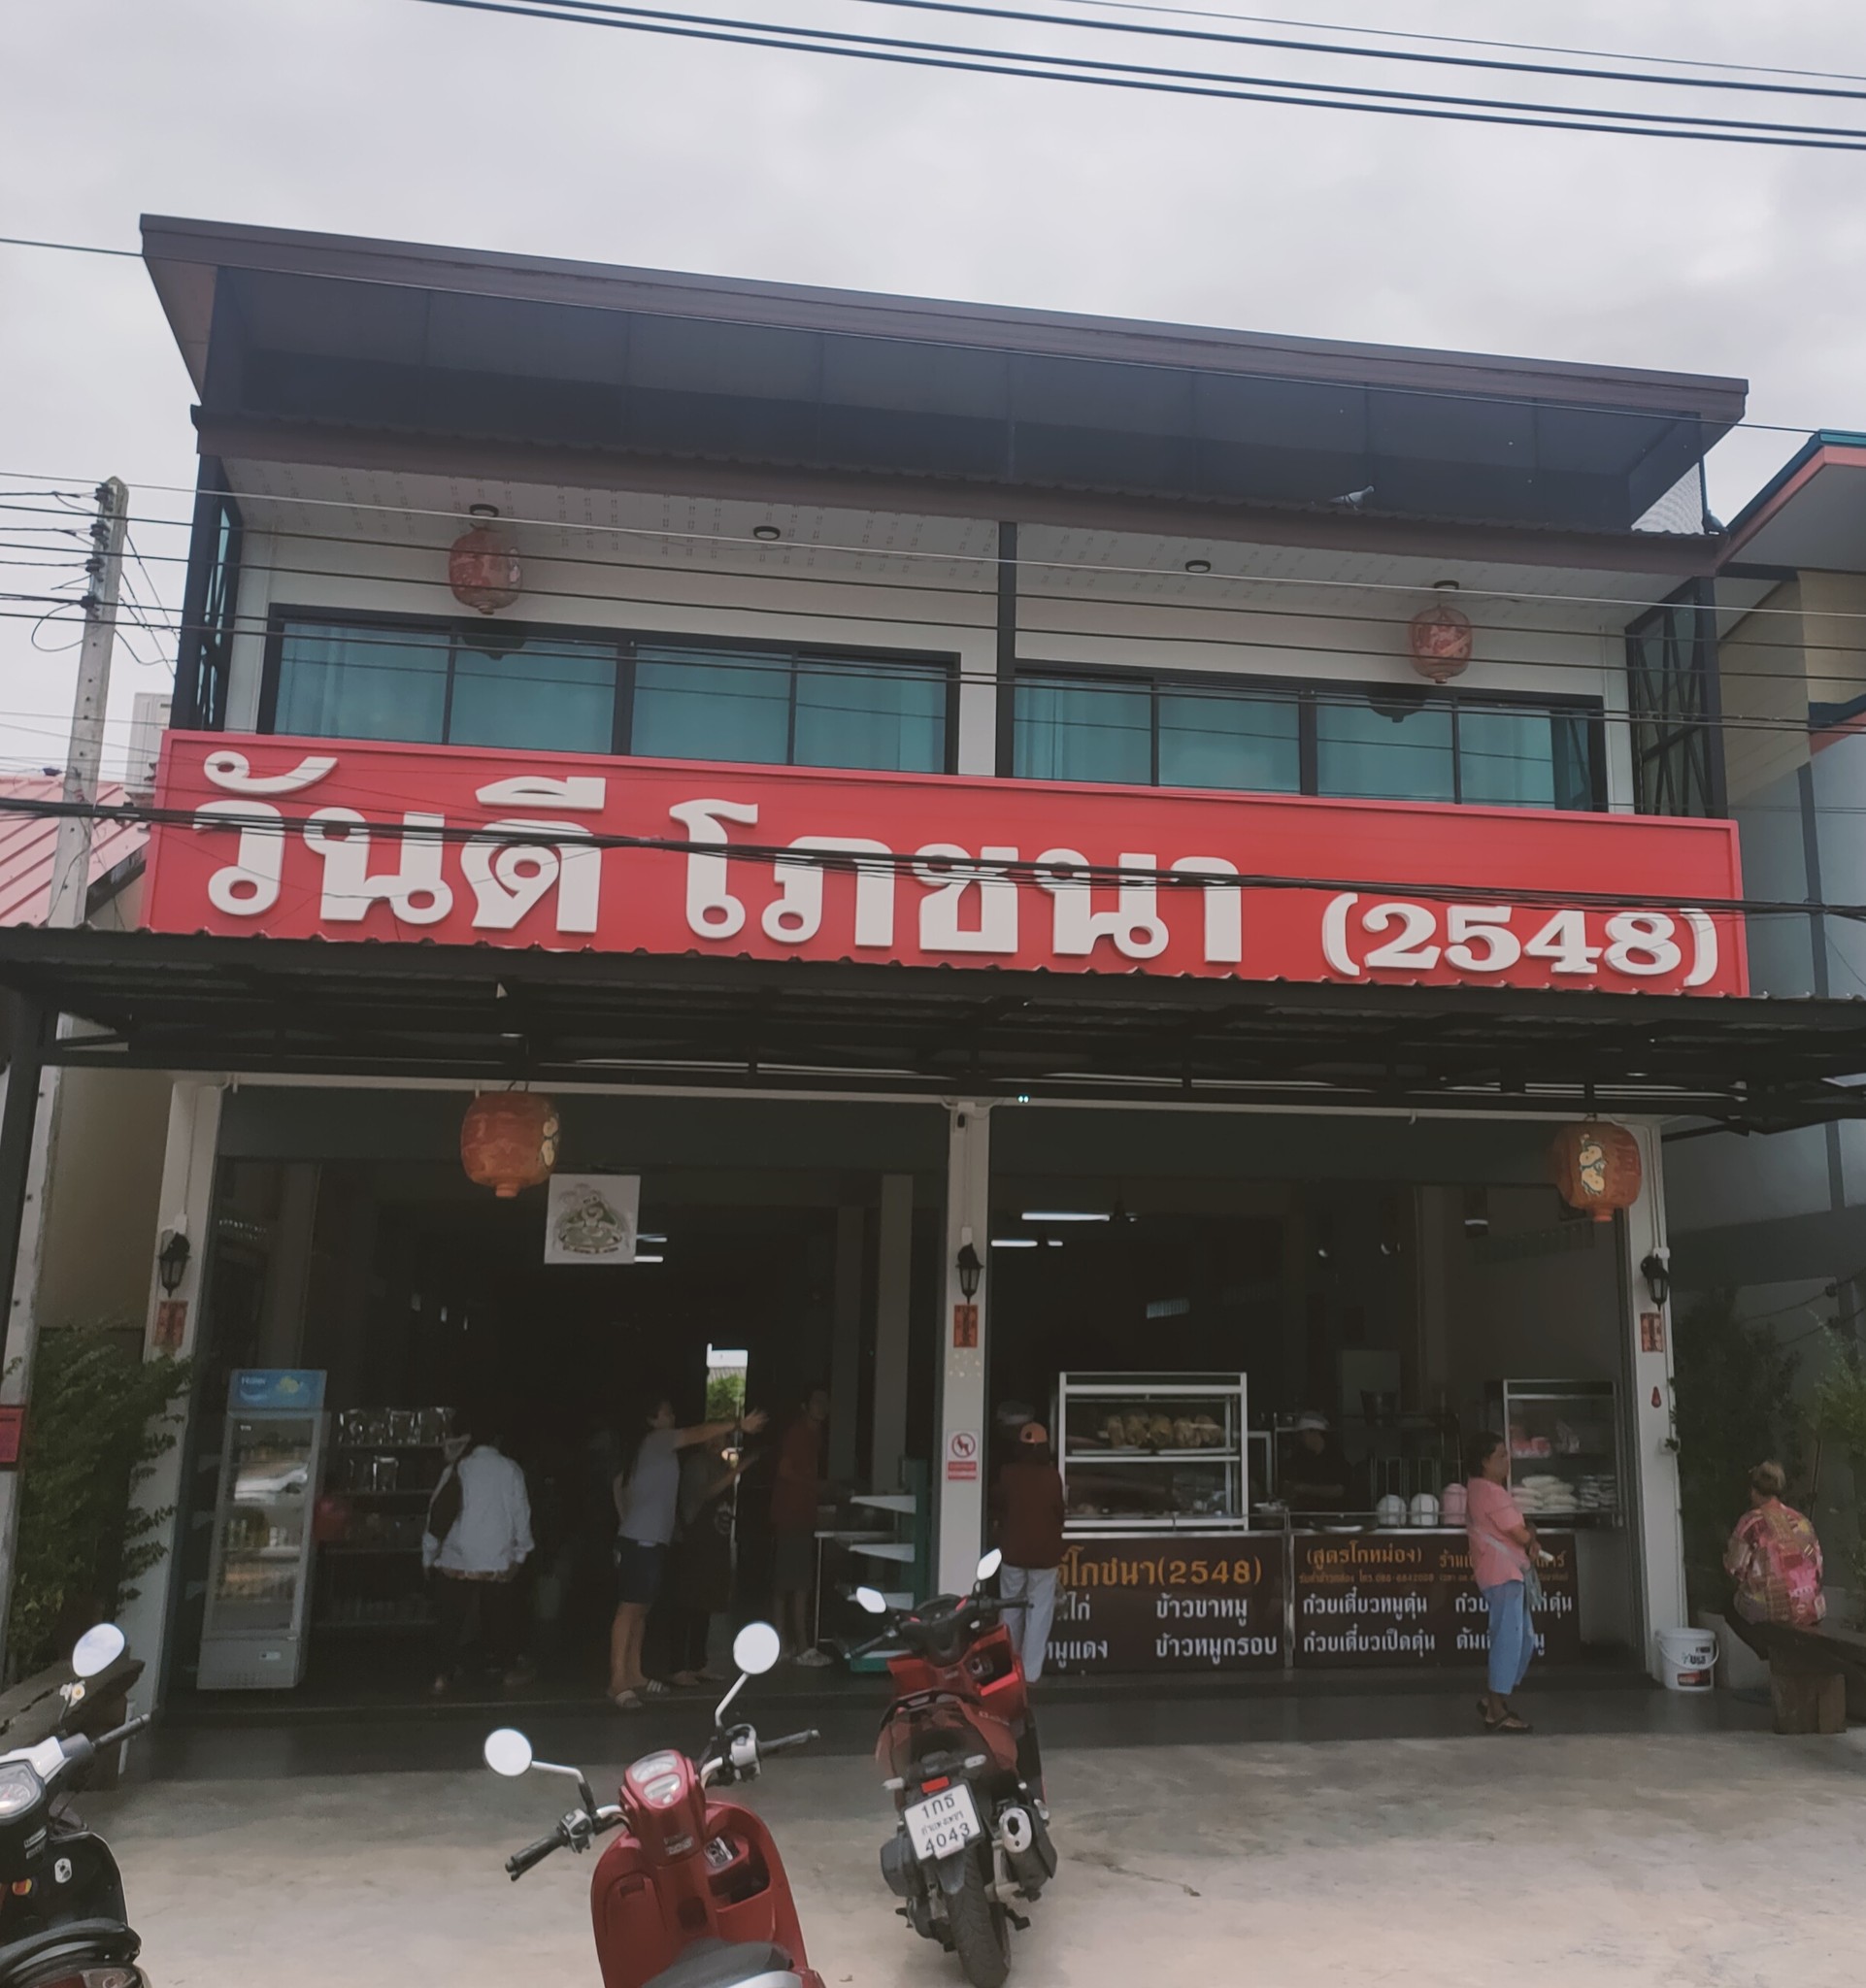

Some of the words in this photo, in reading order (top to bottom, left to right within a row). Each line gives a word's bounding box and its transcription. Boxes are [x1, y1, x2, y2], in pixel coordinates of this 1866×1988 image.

[195, 750, 606, 933] วันดี
[670, 799, 1242, 963] โภชนา
[1321, 892, 1718, 986] (2548)
[1156, 1593, 1248, 1626] ข้าวขาหมู
[1303, 1586, 1427, 1621] ก๋วยเตี๋ยวหมูตุ๋น
[1155, 1634, 1278, 1664] ข้าวหมูกรอบ
[925, 1822, 971, 1855] 4043
